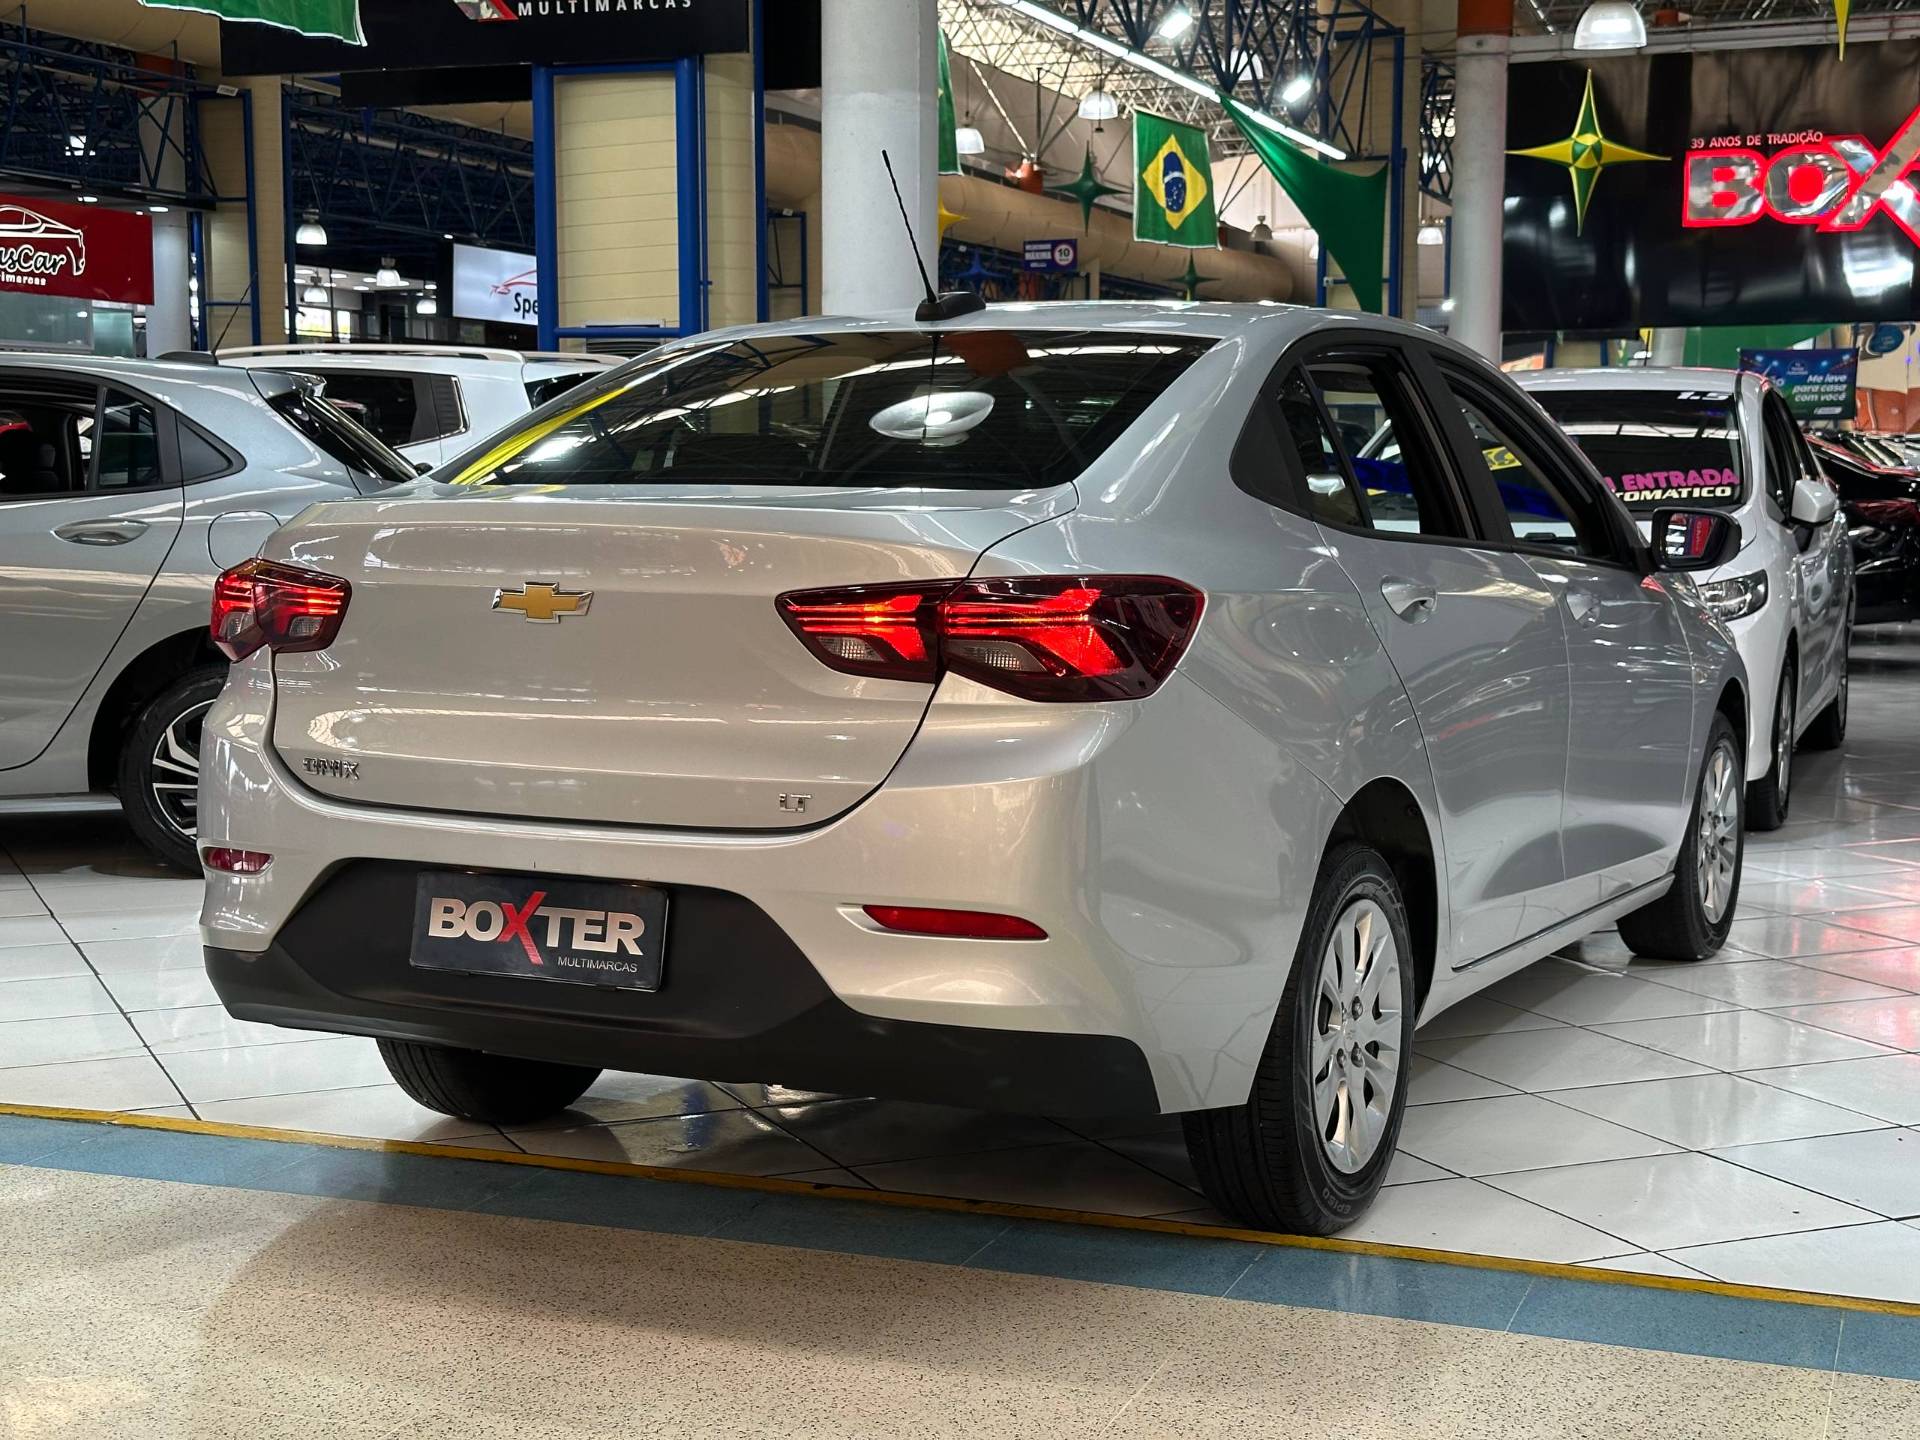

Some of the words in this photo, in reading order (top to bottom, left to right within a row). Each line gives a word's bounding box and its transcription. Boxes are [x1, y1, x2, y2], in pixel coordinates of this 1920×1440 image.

[518, 0, 691, 16] MULTIMARCAS
[1690, 138, 1704, 149] 39
[1709, 136, 1741, 148] ANOS
[1746, 135, 1761, 146] DE
[1767, 129, 1823, 145] TRADIÇÃO
[1058, 248, 1070, 258] 10
[1807, 374, 1824, 383] Me
[1825, 373, 1847, 383] leve
[1792, 384, 1820, 395] para
[1821, 384, 1847, 393] casa
[1795, 394, 1818, 402] com
[1820, 392, 1846, 401] você
[1621, 467, 1740, 491] ENTRADA
[302, 757, 360, 781] ONIX
[779, 793, 813, 813] LT
[428, 891, 645, 966] BOXTER
[557, 955, 639, 974] MULTIMARCAS
